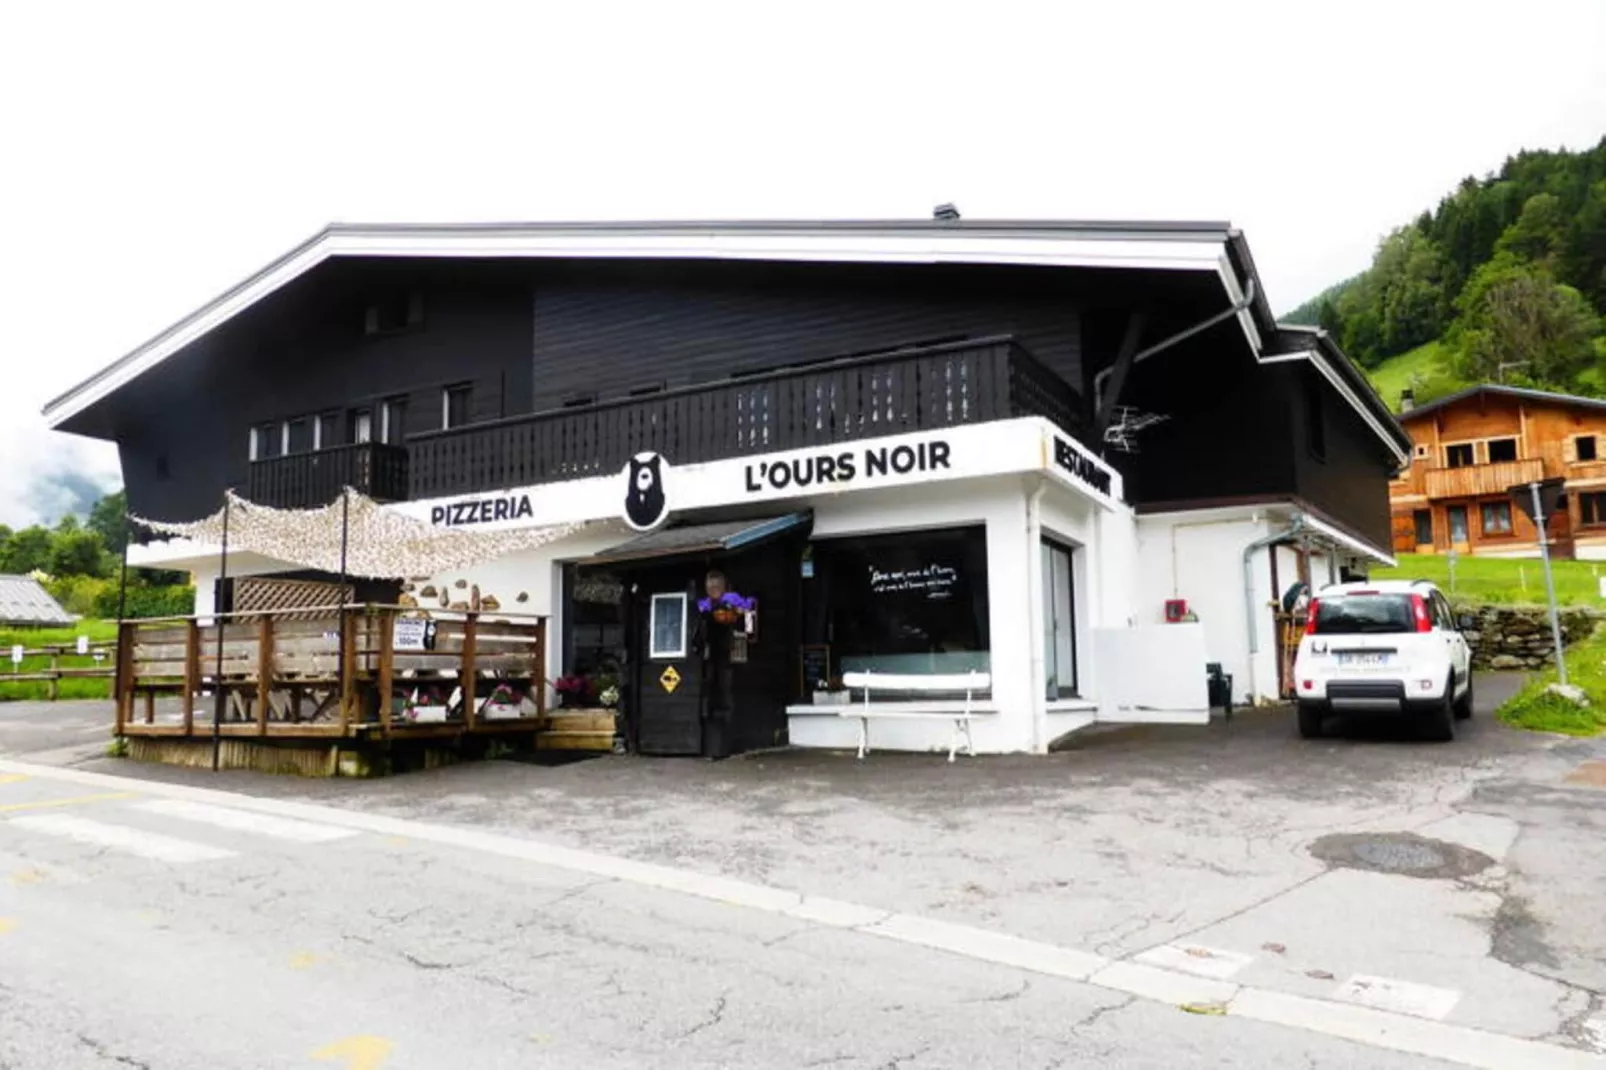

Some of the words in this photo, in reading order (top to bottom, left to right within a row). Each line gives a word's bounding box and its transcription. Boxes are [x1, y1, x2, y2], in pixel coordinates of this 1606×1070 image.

[745, 452, 855, 493] L'OURS
[865, 441, 951, 477] NOIR
[431, 494, 533, 526] PIZZERIA
